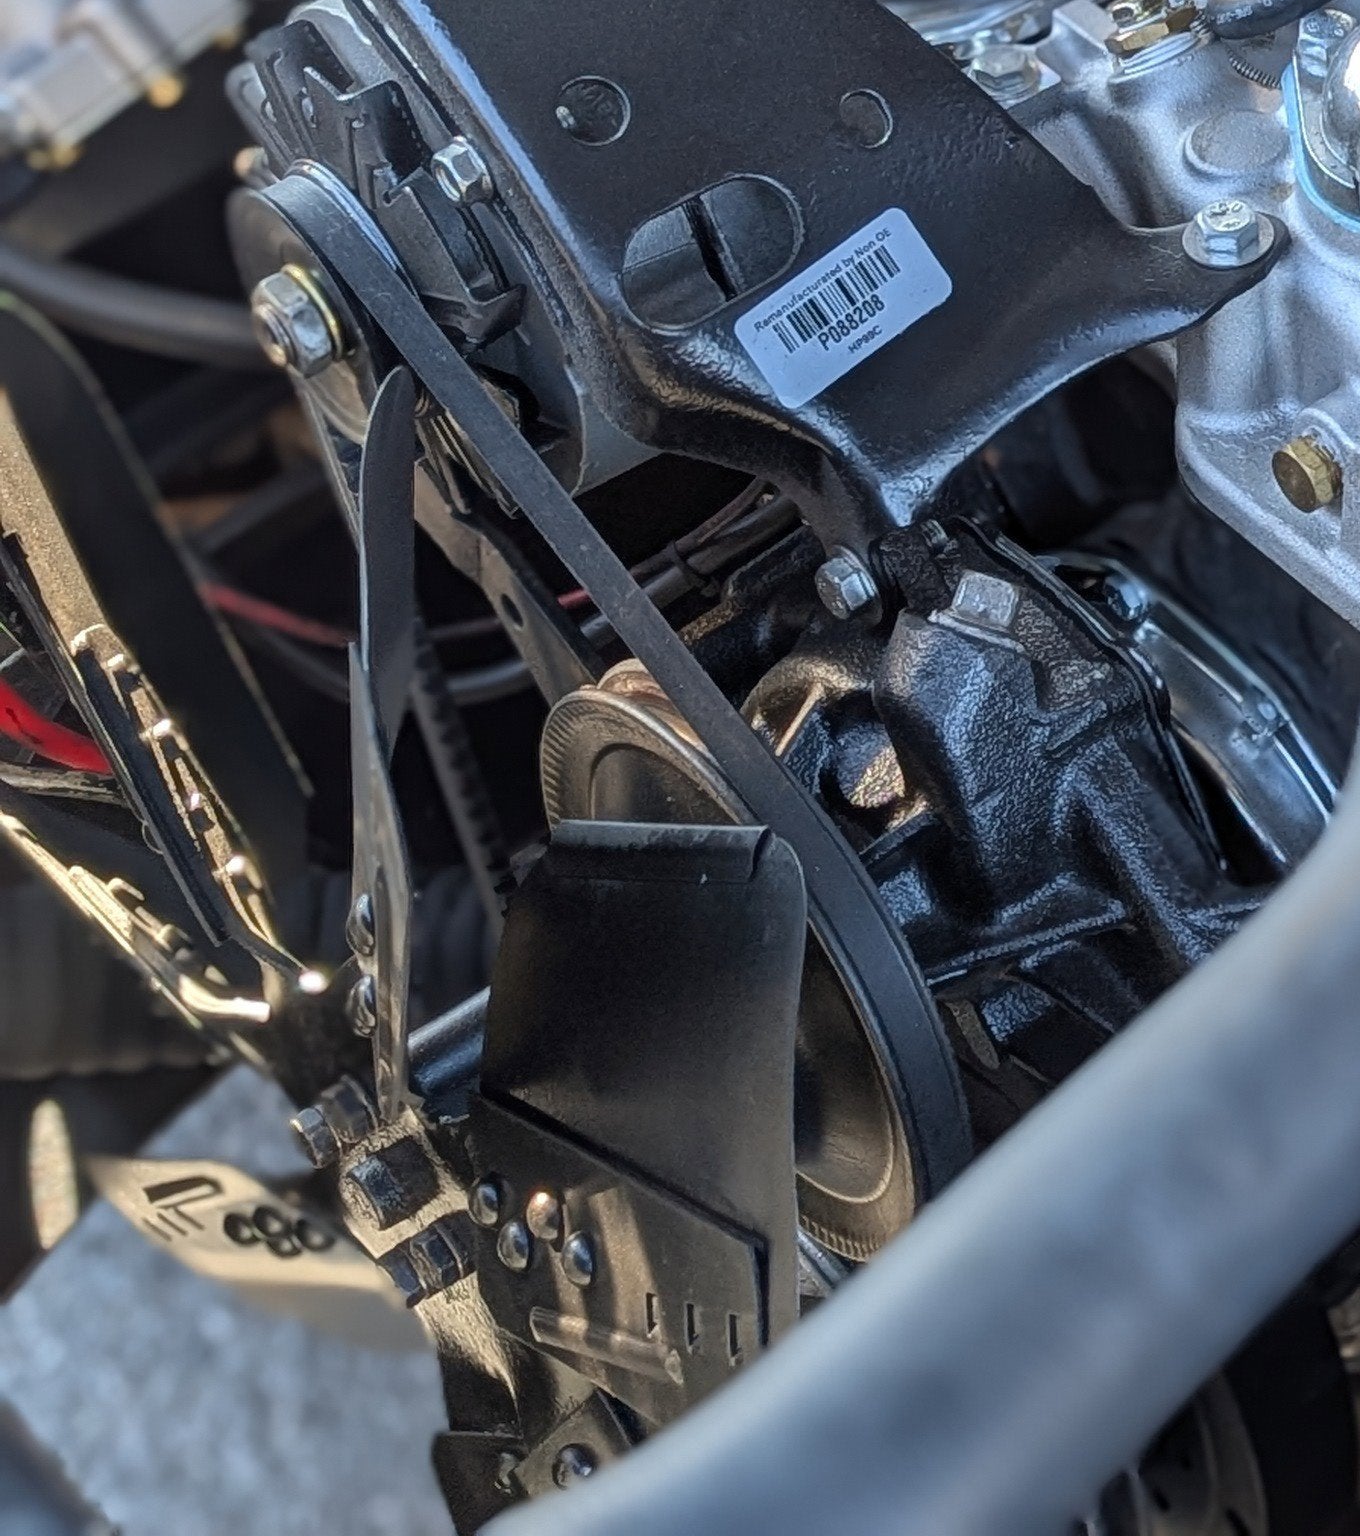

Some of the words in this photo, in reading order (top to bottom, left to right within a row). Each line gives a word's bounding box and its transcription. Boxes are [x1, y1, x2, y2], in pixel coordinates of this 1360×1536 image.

[842, 254, 856, 269] by
[854, 241, 876, 259] Non
[875, 227, 892, 242] OE
[818, 293, 886, 352] P088208
